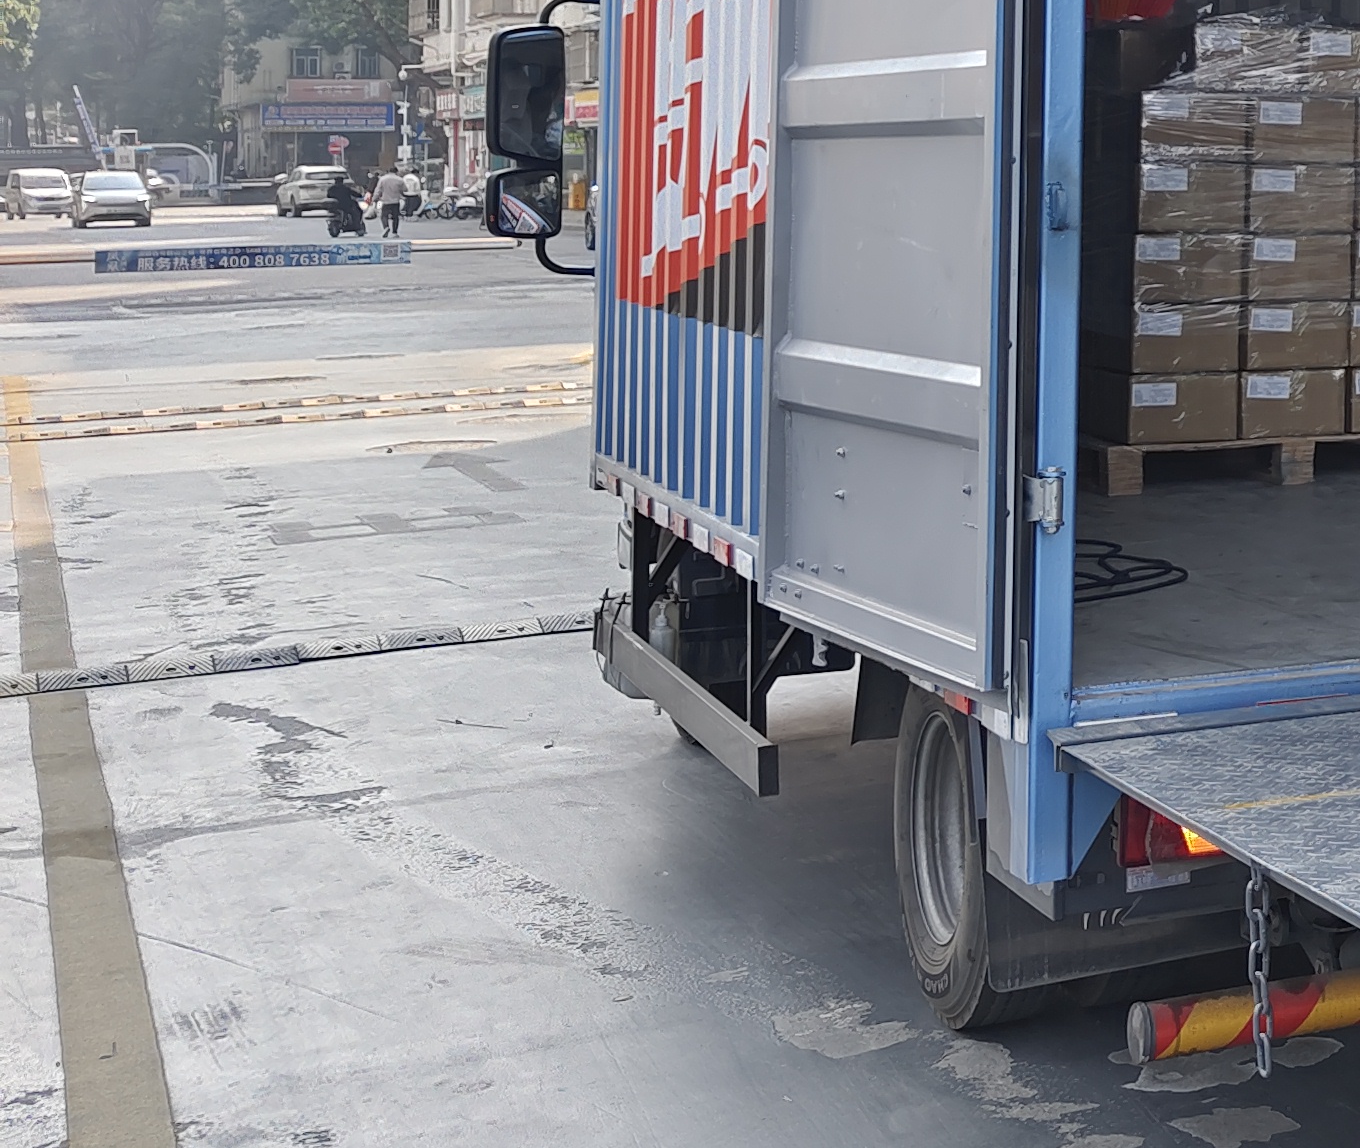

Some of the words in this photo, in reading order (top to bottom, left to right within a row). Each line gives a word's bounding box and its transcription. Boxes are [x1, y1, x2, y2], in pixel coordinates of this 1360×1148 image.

[218, 254, 250, 269] 400
[255, 254, 285, 267] 808
[290, 252, 331, 266] 7638
